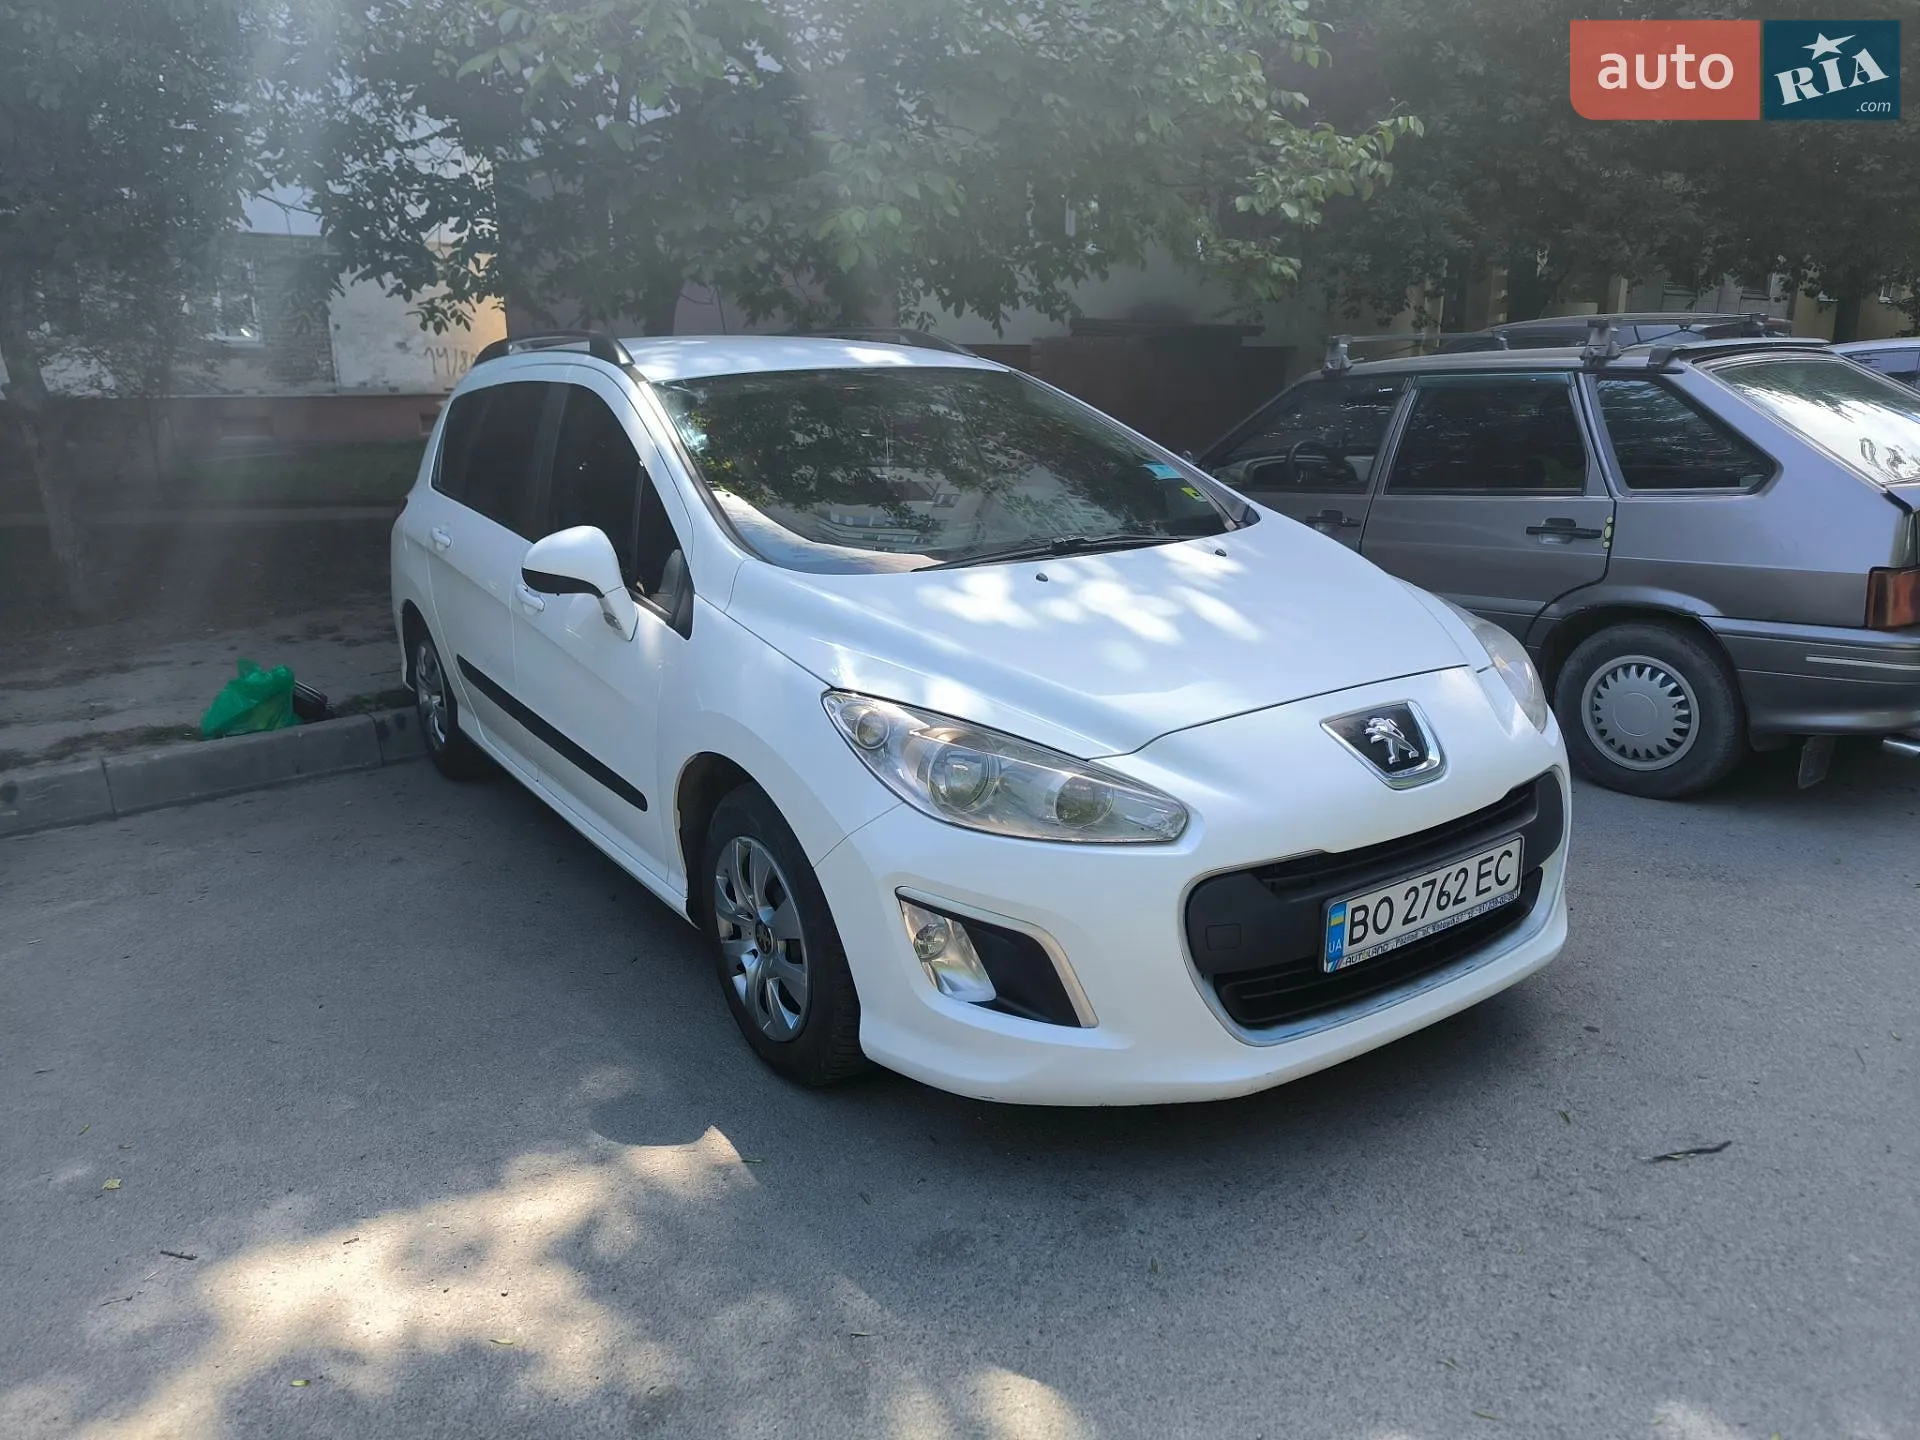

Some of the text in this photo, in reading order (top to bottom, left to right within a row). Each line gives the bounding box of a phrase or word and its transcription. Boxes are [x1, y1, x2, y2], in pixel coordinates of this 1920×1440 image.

[1348, 895, 1394, 947] BO
[1401, 867, 1469, 926] 2762
[1475, 850, 1513, 897] EC
[1328, 939, 1342, 953] UA
